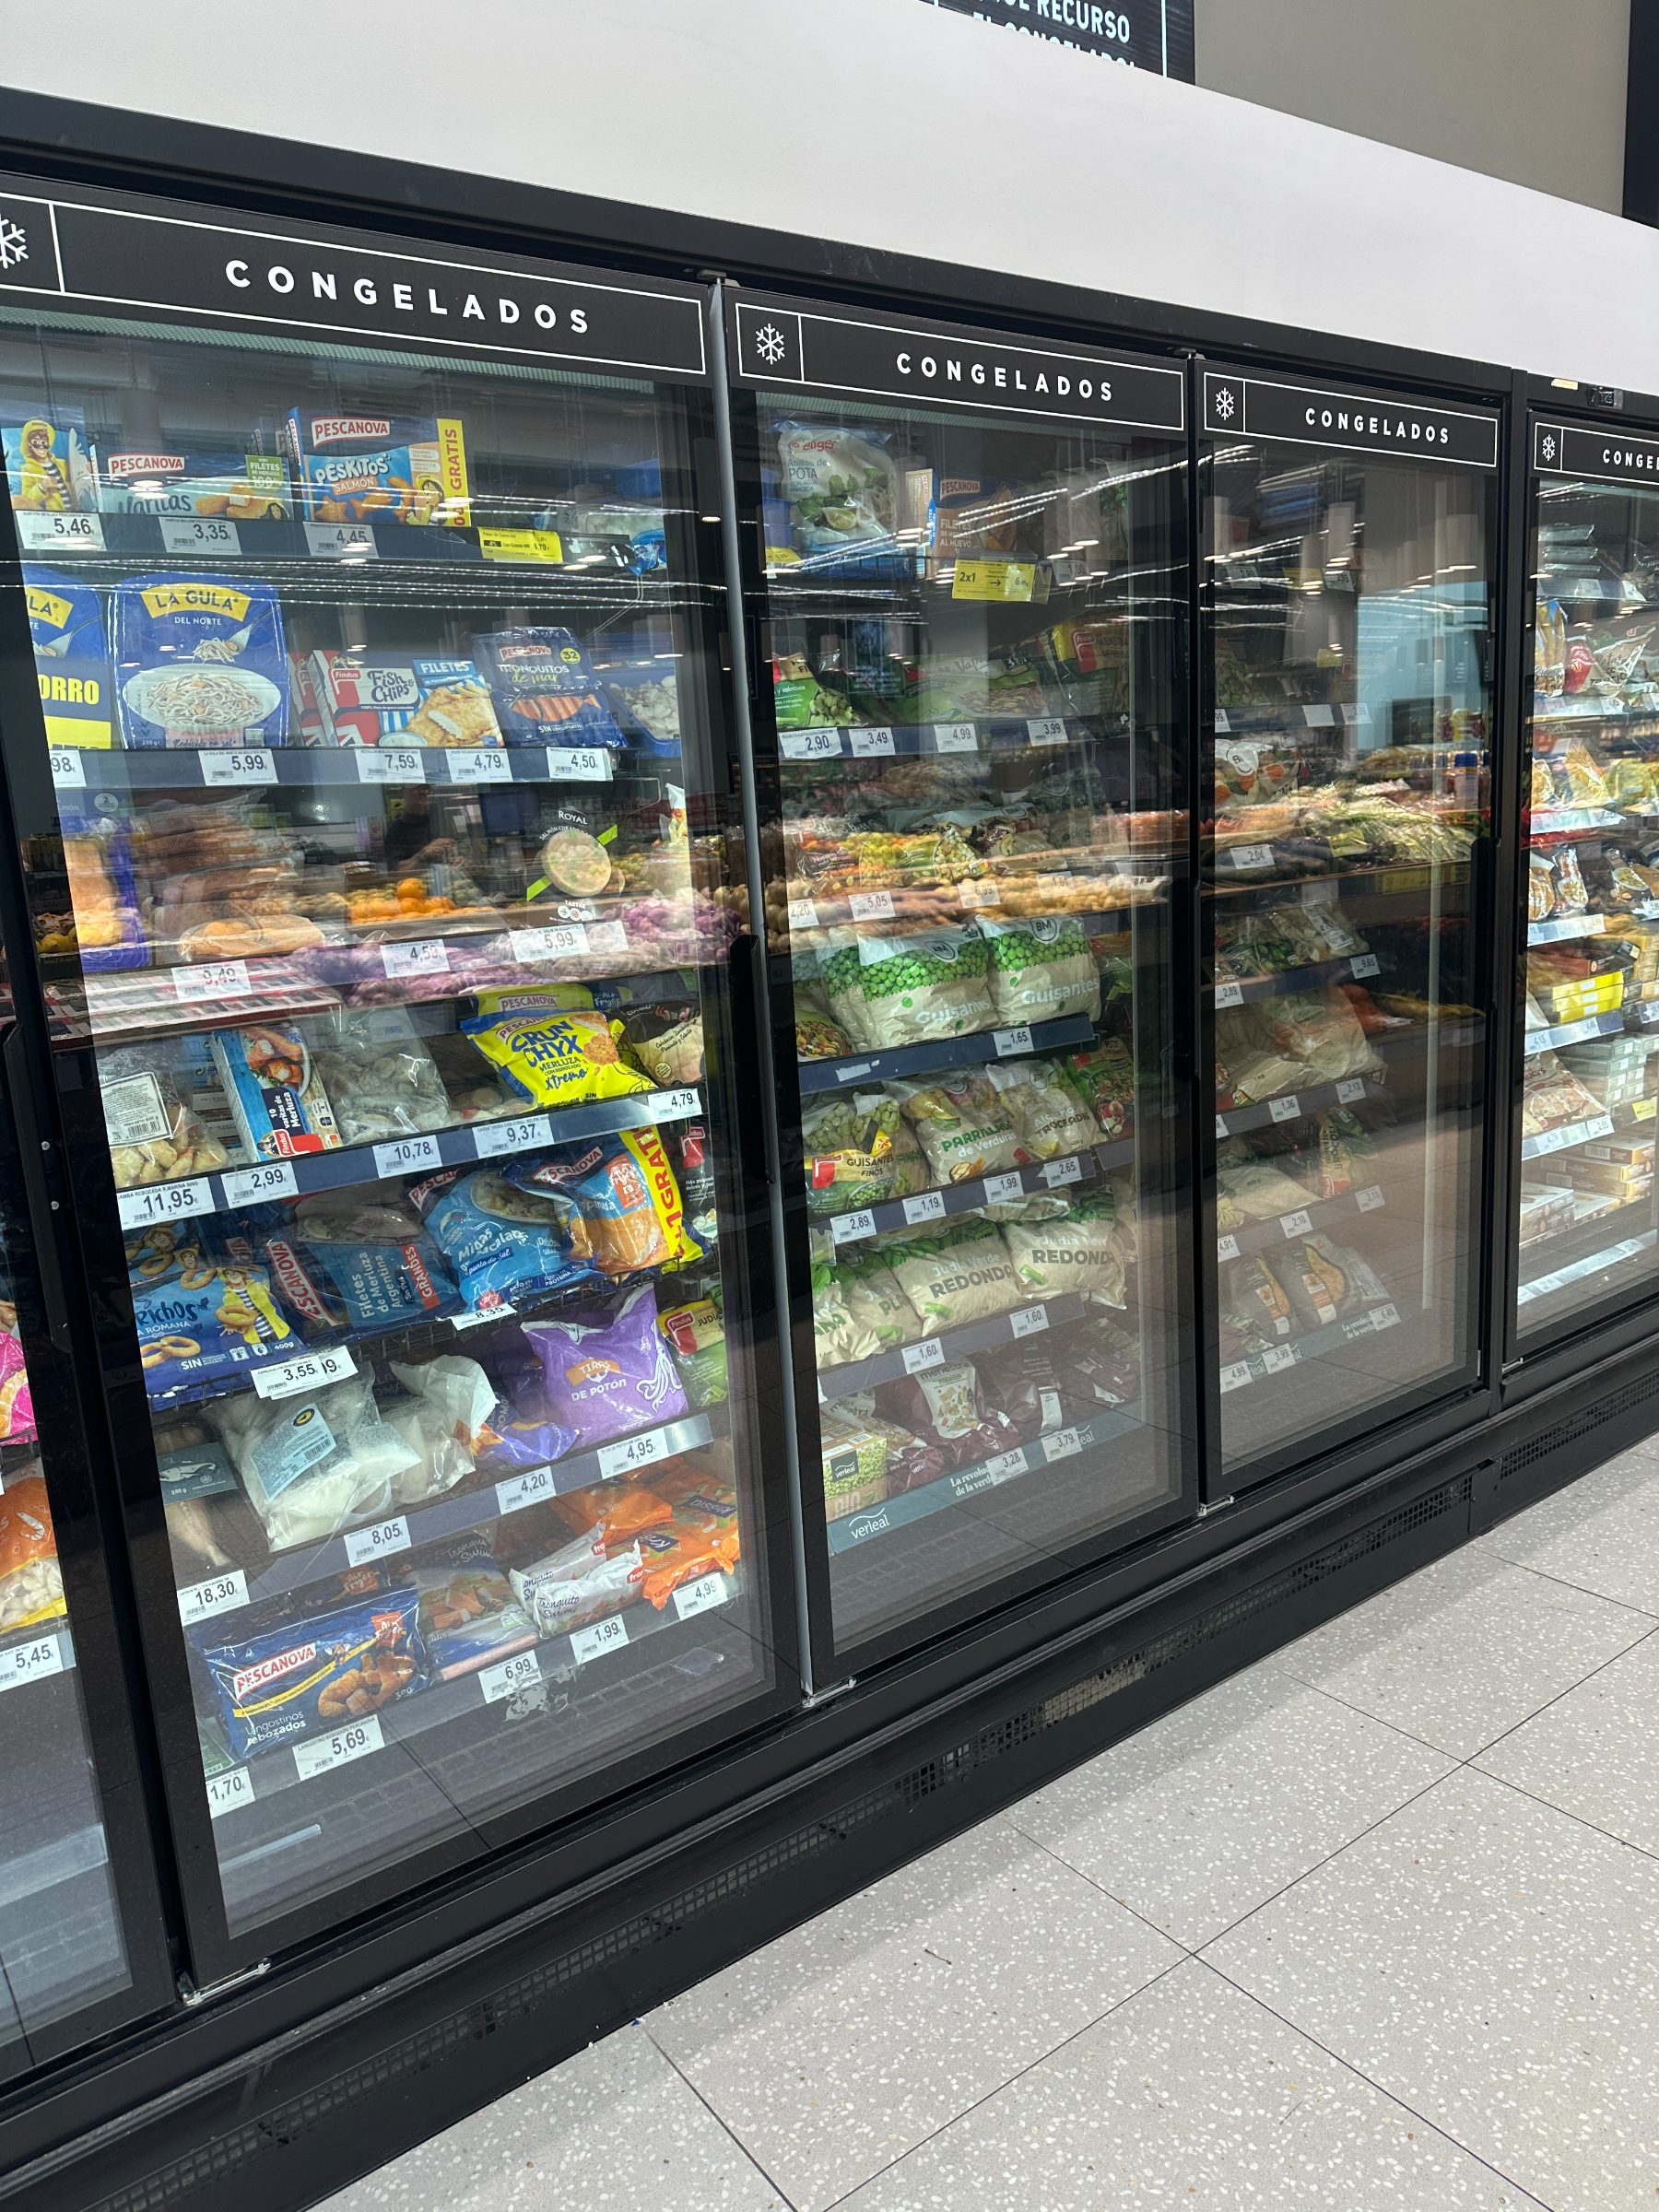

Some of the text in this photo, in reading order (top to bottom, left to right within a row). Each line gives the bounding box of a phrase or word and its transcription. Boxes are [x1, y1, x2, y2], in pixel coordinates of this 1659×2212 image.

[1037, 0, 1130, 42] RECURSO
[225, 259, 589, 334] CONGELADOS
[897, 353, 1112, 401] CONGELADOS
[314, 421, 389, 440] PESCANOVA
[1305, 407, 1450, 445] CONGELADOS
[111, 456, 184, 473] PESCANOVA
[445, 429, 463, 490] GRATIS
[789, 468, 818, 480] POTA
[942, 481, 980, 493] PESCANOVA
[959, 572, 976, 582] 2x1
[155, 590, 233, 610] LA GULA
[194, 617, 222, 626] NORTE
[563, 651, 579, 660] 32
[421, 662, 470, 674] FILETES
[498, 665, 570, 674] TRONQUITOS
[559, 810, 588, 825] ROYAL
[1022, 979, 1100, 1004] Guisantes
[500, 995, 556, 1010] PESCANOVA
[915, 1000, 990, 1024] Guisantes
[511, 1020, 574, 1053] CRUN
[524, 1035, 583, 1068] CHYX
[539, 1057, 581, 1073] MERLUZA
[270, 1108, 276, 1118] 10
[280, 1103, 289, 1130] varitas
[284, 1090, 300, 1128] Merluza
[282, 1133, 291, 1154] Findus
[959, 1147, 973, 1158] de
[846, 1155, 894, 1167] GUISANTES
[861, 1168, 884, 1176] FINOS
[969, 1253, 1001, 1268] Verde
[276, 1243, 320, 1315] ESCANOVA
[359, 1252, 389, 1312] de Merluza
[375, 1254, 404, 1308] Argentina
[406, 1246, 433, 1298] GRANDES
[929, 1265, 1015, 1298] REDONDA
[352, 1274, 375, 1318] Filetes
[879, 1295, 910, 1316] PLA
[145, 1321, 191, 1334] ROMANA
[181, 1359, 203, 1371] SIN
[571, 1392, 588, 1401] DE
[950, 1477, 961, 1487] La
[956, 1484, 974, 1498] de la
[851, 1514, 889, 1539] verleal
[538, 1596, 580, 1610] Tronquito
[237, 1647, 315, 1692] PESCANOVA
[246, 1711, 304, 1734] Langostinos
[247, 1720, 307, 1744] rebozados
